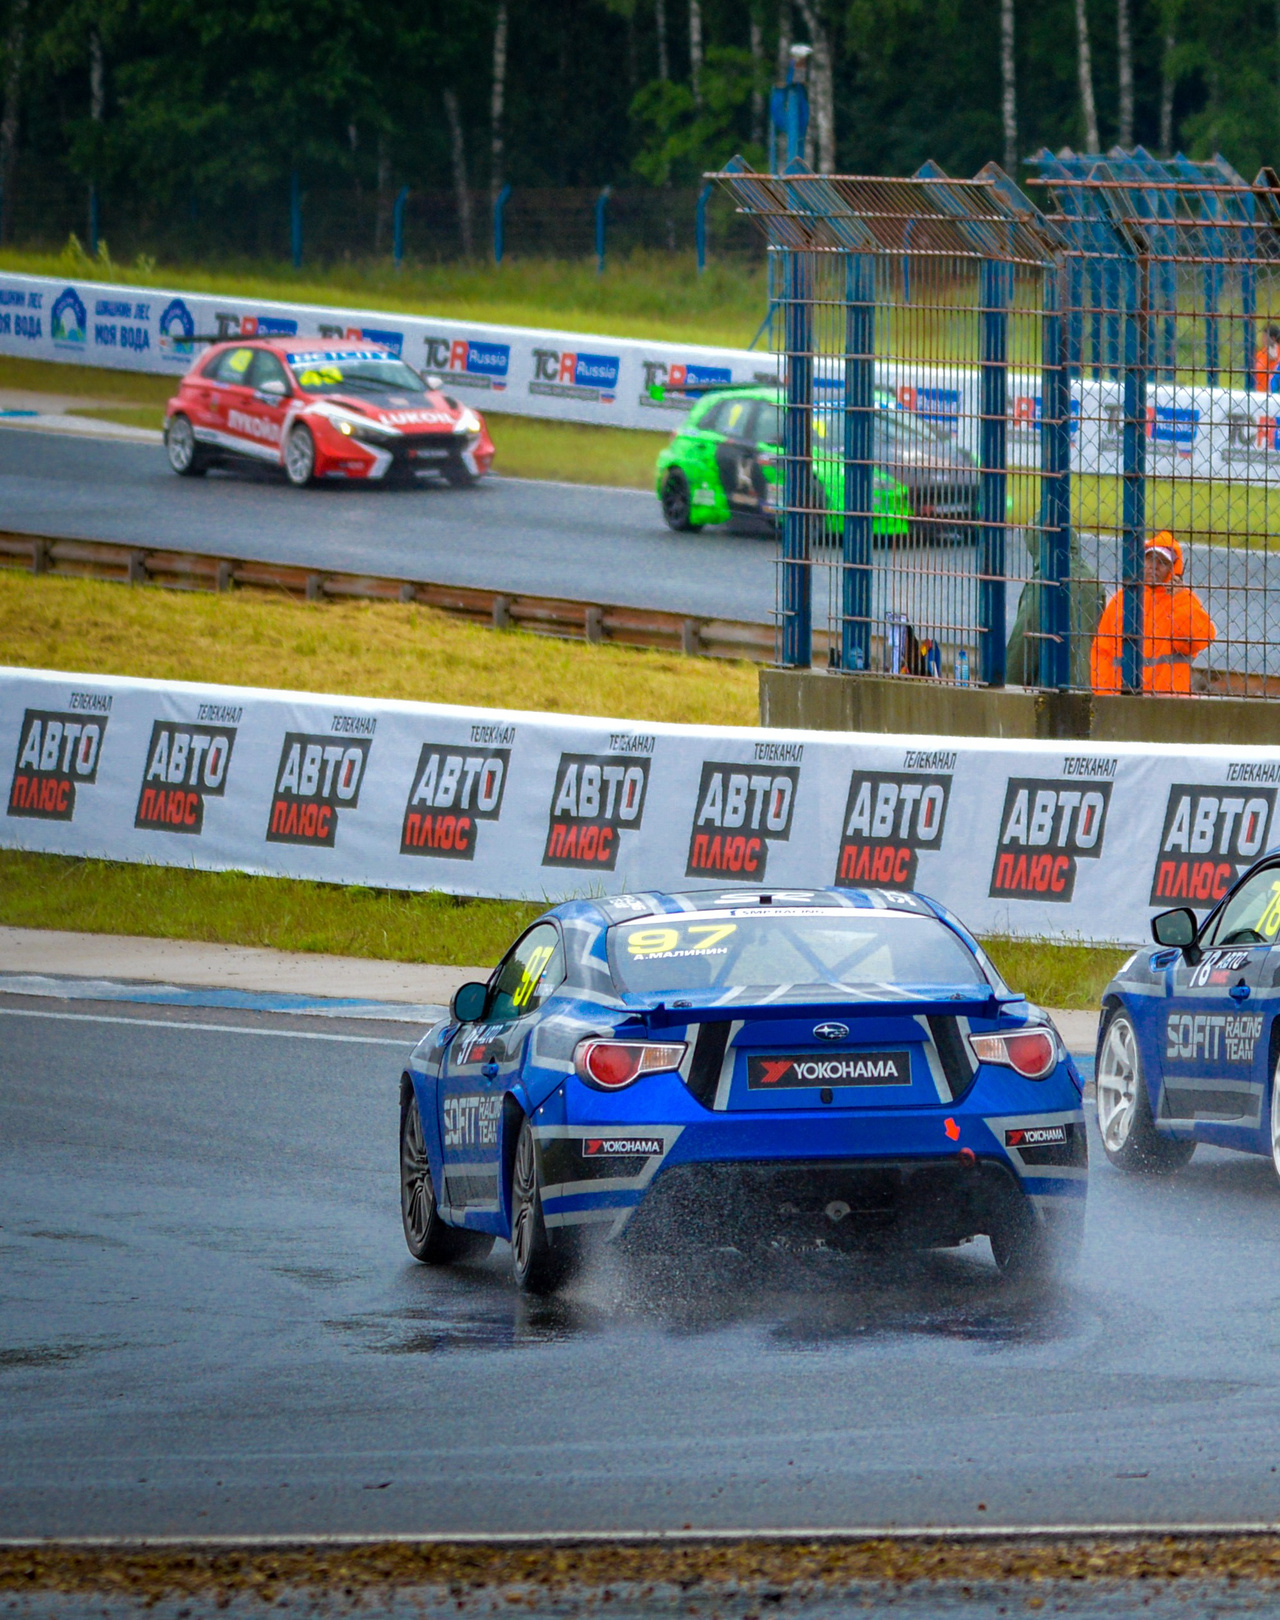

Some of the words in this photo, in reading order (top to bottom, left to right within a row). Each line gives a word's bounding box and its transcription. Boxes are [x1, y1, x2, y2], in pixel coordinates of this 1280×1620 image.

[14, 314, 42, 340] ВОДА
[95, 324, 117, 346] МОЯ
[120, 325, 150, 352] ВОДА
[424, 336, 469, 371] TCR
[468, 349, 507, 366] Russia
[532, 348, 578, 384] TCR
[69, 693, 113, 712] ТЕЛЕКАНАЛ
[197, 704, 243, 724] ТЕЛЕКАНАЛ
[331, 715, 377, 734] ТЕЛЕКАНАЛ
[470, 725, 515, 745] ТЕЛЕКАНАЛ
[19, 720, 99, 775] АВТО
[147, 731, 229, 788] АВТО
[609, 734, 655, 753] ТЕЛЕКАНАЛ
[754, 743, 804, 762] ТЕЛЕКАНАЛ
[904, 751, 957, 770] ТЕЛЕКАНАЛ
[278, 743, 363, 800] АВТО
[412, 754, 504, 812] АВТО
[1063, 757, 1118, 777] ТЕЛЕКАНАЛ
[12, 777, 70, 812] ПЛЮС
[140, 788, 198, 825] ПЛЮС
[554, 764, 645, 821] АВТО
[698, 772, 794, 831] АВТО
[846, 781, 945, 840] АВТО
[271, 801, 332, 838] ПЛЮС
[405, 813, 471, 850] ПЛЮС
[1002, 789, 1104, 848] АВТО
[1164, 795, 1270, 856] АВТО
[548, 824, 613, 861] ПЛЮС
[691, 835, 761, 872] ПЛЮС
[840, 845, 911, 882] ПЛЮС
[995, 854, 1069, 892] ПЛЮС
[1155, 861, 1232, 900] ПЛЮС
[627, 923, 738, 955] 97
[633, 947, 728, 962] А.МАЛИНИН
[512, 946, 555, 1007] 97
[1189, 950, 1222, 987] 78
[1166, 1014, 1227, 1060] SOFIT
[1225, 1015, 1262, 1039] RACING
[1225, 1039, 1254, 1061] TEAM
[793, 1061, 899, 1080] YOKOHAMA
[443, 1097, 480, 1146] SOFIT
[479, 1120, 498, 1144] TEAM
[1023, 1129, 1065, 1143] YOKOHAMA
[602, 1139, 660, 1153] YOKOHAMA
